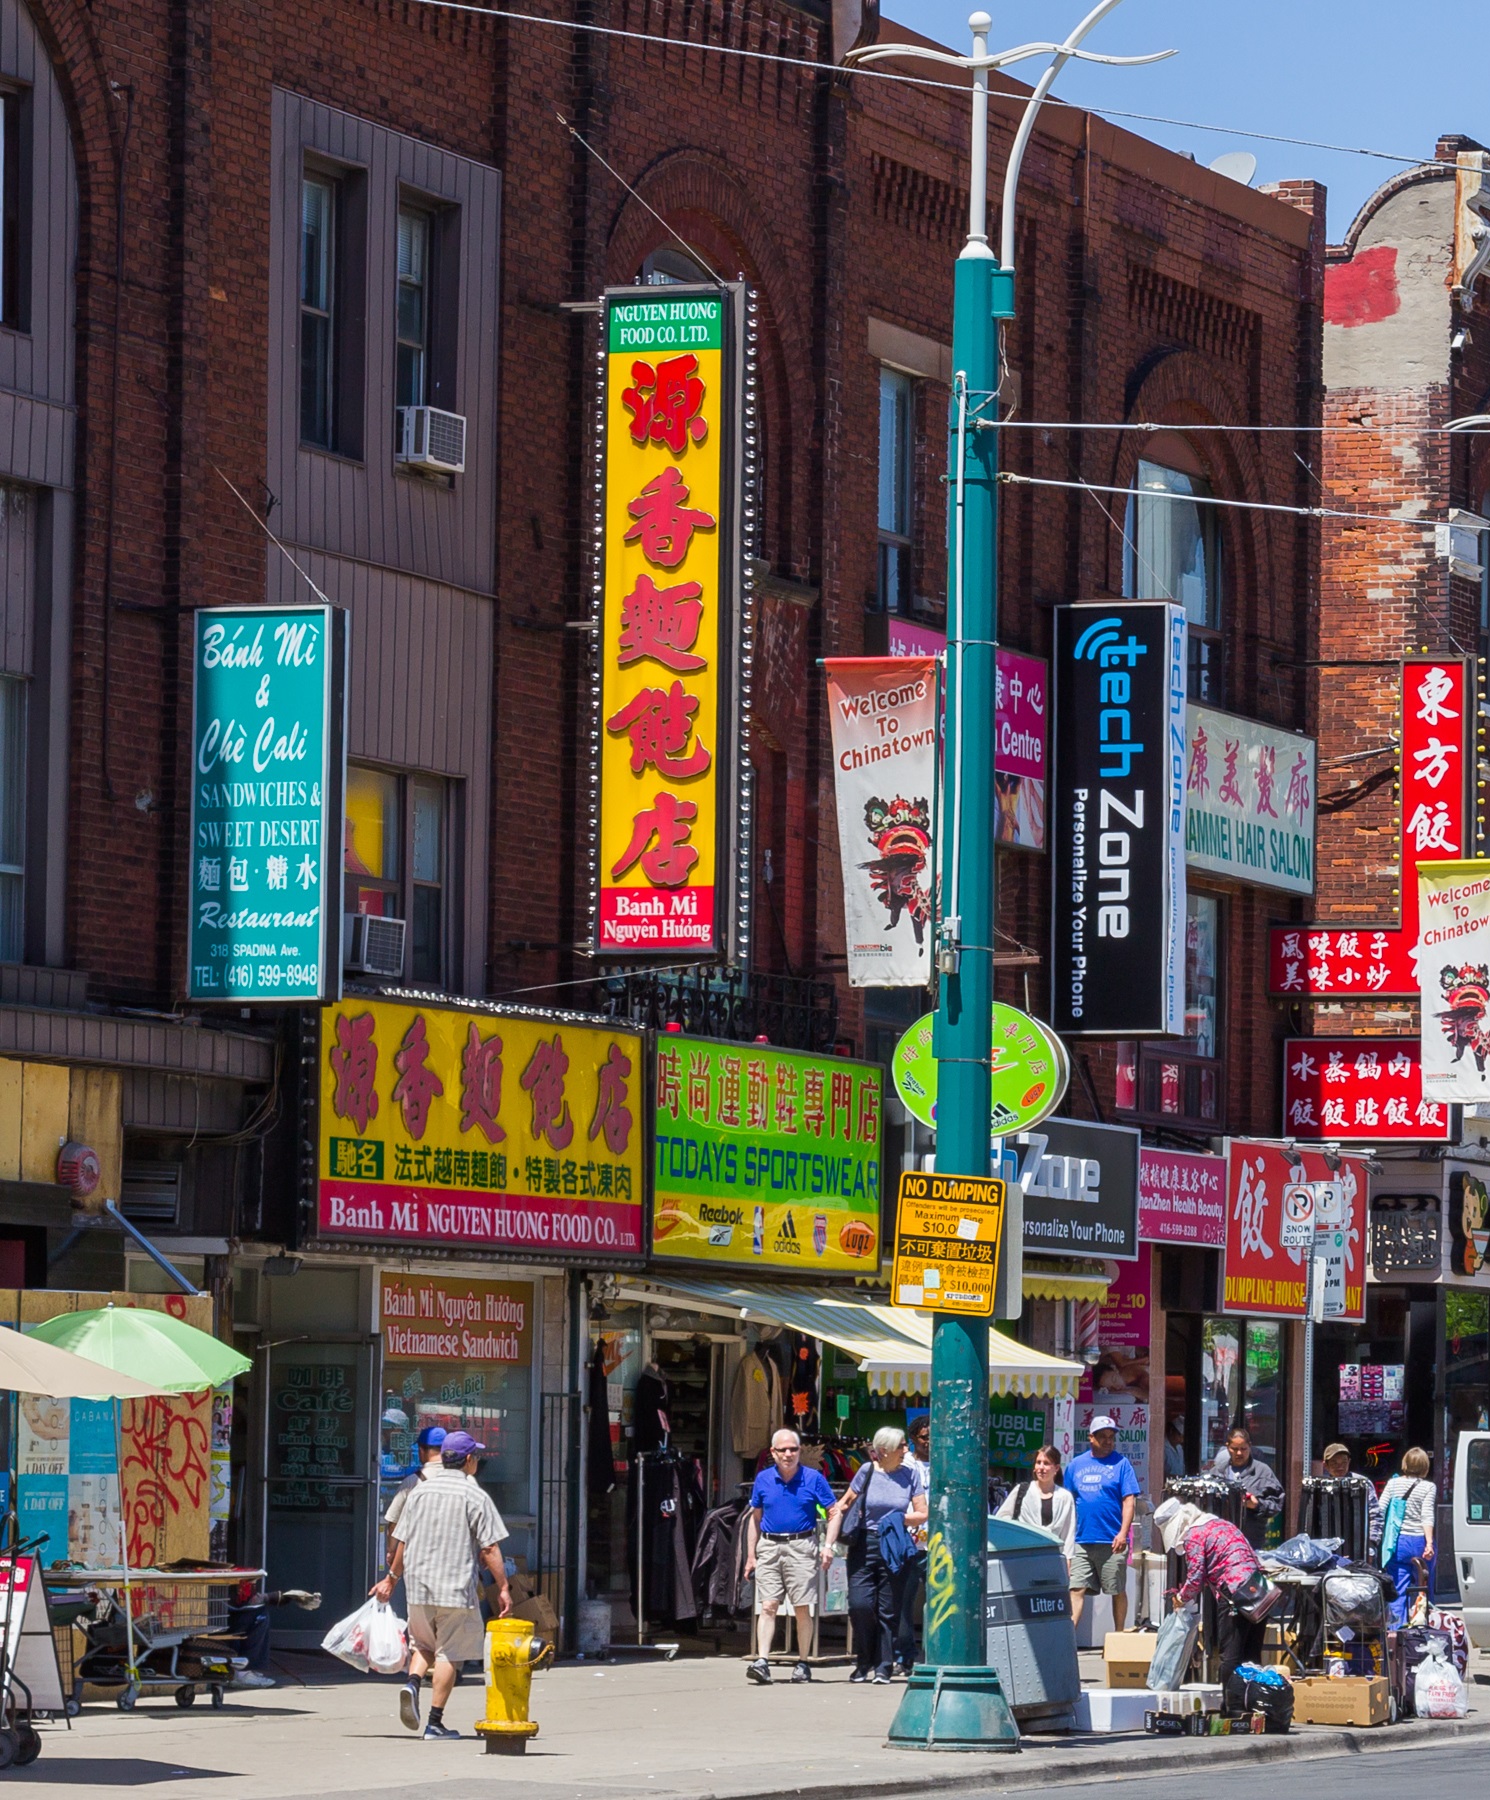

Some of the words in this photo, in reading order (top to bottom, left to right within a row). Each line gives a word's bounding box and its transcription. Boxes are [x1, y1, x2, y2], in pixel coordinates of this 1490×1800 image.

[615, 304, 668, 322] NGUYEN
[670, 302, 717, 320] HUONG
[621, 327, 654, 344] FOOD
[657, 326, 677, 343] CO.
[681, 325, 710, 342] LTD.
[203, 623, 264, 669] Bánh
[275, 622, 319, 666] Mì
[1170, 612, 1186, 716] tech
[255, 673, 270, 708] &
[838, 680, 927, 723] Welcome
[1100, 636, 1148, 778] tech
[876, 715, 899, 737] To
[253, 716, 308, 773] Cali
[840, 727, 935, 772] Chinatown
[1001, 721, 1041, 763] Centre
[1169, 720, 1185, 834] Zone
[200, 781, 307, 809] SANDWICHES
[310, 785, 321, 806] &
[199, 820, 254, 848] SWEET
[259, 819, 320, 847] DESERT
[1073, 788, 1088, 903] Personalize
[1097, 789, 1144, 938] Zone
[1236, 824, 1266, 869] HAIR
[1269, 827, 1311, 882] SALON
[199, 901, 319, 929] Restaurant
[616, 892, 665, 916] Bánh
[669, 891, 697, 915] Mì
[1453, 904, 1471, 922] To
[603, 918, 658, 943] Nguyên
[1071, 906, 1088, 953] Your
[210, 944, 229, 958] 318
[233, 943, 277, 957] SPADINA
[280, 943, 301, 957] Ave.
[195, 965, 219, 988] TEL:
[223, 963, 254, 989] (416)
[257, 963, 318, 987] 599-8948
[1071, 955, 1087, 1019] Phone
[656, 1136, 741, 1186] TODAYS
[745, 1144, 879, 1201] SPORTSWEAR
[1018, 1132, 1100, 1203] Zone
[905, 1179, 927, 1196] NO
[932, 1180, 998, 1203] DUMPING
[329, 1195, 384, 1231] Bánh
[390, 1193, 419, 1232] Mì
[427, 1203, 491, 1236] NGUYEN
[494, 1207, 549, 1240] HUONG
[552, 1213, 592, 1243] FOOD
[594, 1217, 618, 1245] CO.
[620, 1232, 636, 1246] LTD.
[906, 1201, 935, 1210] Offenders
[960, 1207, 994, 1215] prosecuted
[915, 1210, 959, 1220] Maximum
[1172, 1195, 1197, 1214] Health
[1198, 1198, 1223, 1222] Beauty
[699, 1203, 743, 1225] Reebok
[774, 1239, 801, 1255] adidas
[846, 1228, 870, 1257] Lugz
[923, 1221, 958, 1236] $10,0
[1070, 1220, 1093, 1240] Your
[1095, 1223, 1125, 1244] Phone
[1159, 1223, 1197, 1237] 416-599-8288
[1284, 1236, 1311, 1244] ROUTE
[1286, 1225, 1310, 1233] SNOW
[901, 1239, 992, 1262] 不可棄置垃圾
[1330, 1257, 1340, 1265] AM
[950, 1281, 991, 1293] $10,000
[1225, 1276, 1273, 1304] DUMPLING
[1274, 1280, 1305, 1307] HOUSE
[1330, 1279, 1340, 1287] PM
[383, 1282, 415, 1317] Bánh
[419, 1282, 434, 1318] Mì
[437, 1291, 481, 1327] Nguyên
[387, 1325, 459, 1356] Vietnamese
[462, 1330, 518, 1360] Sandwich
[275, 1389, 352, 1412] Café
[996, 1431, 1026, 1448] TEA
[1119, 1430, 1147, 1442] SALON
[49, 1462, 64, 1474] OFF
[30, 1498, 48, 1510] DAY
[48, 1498, 65, 1510] OFF
[1030, 1598, 1055, 1613] Litter
